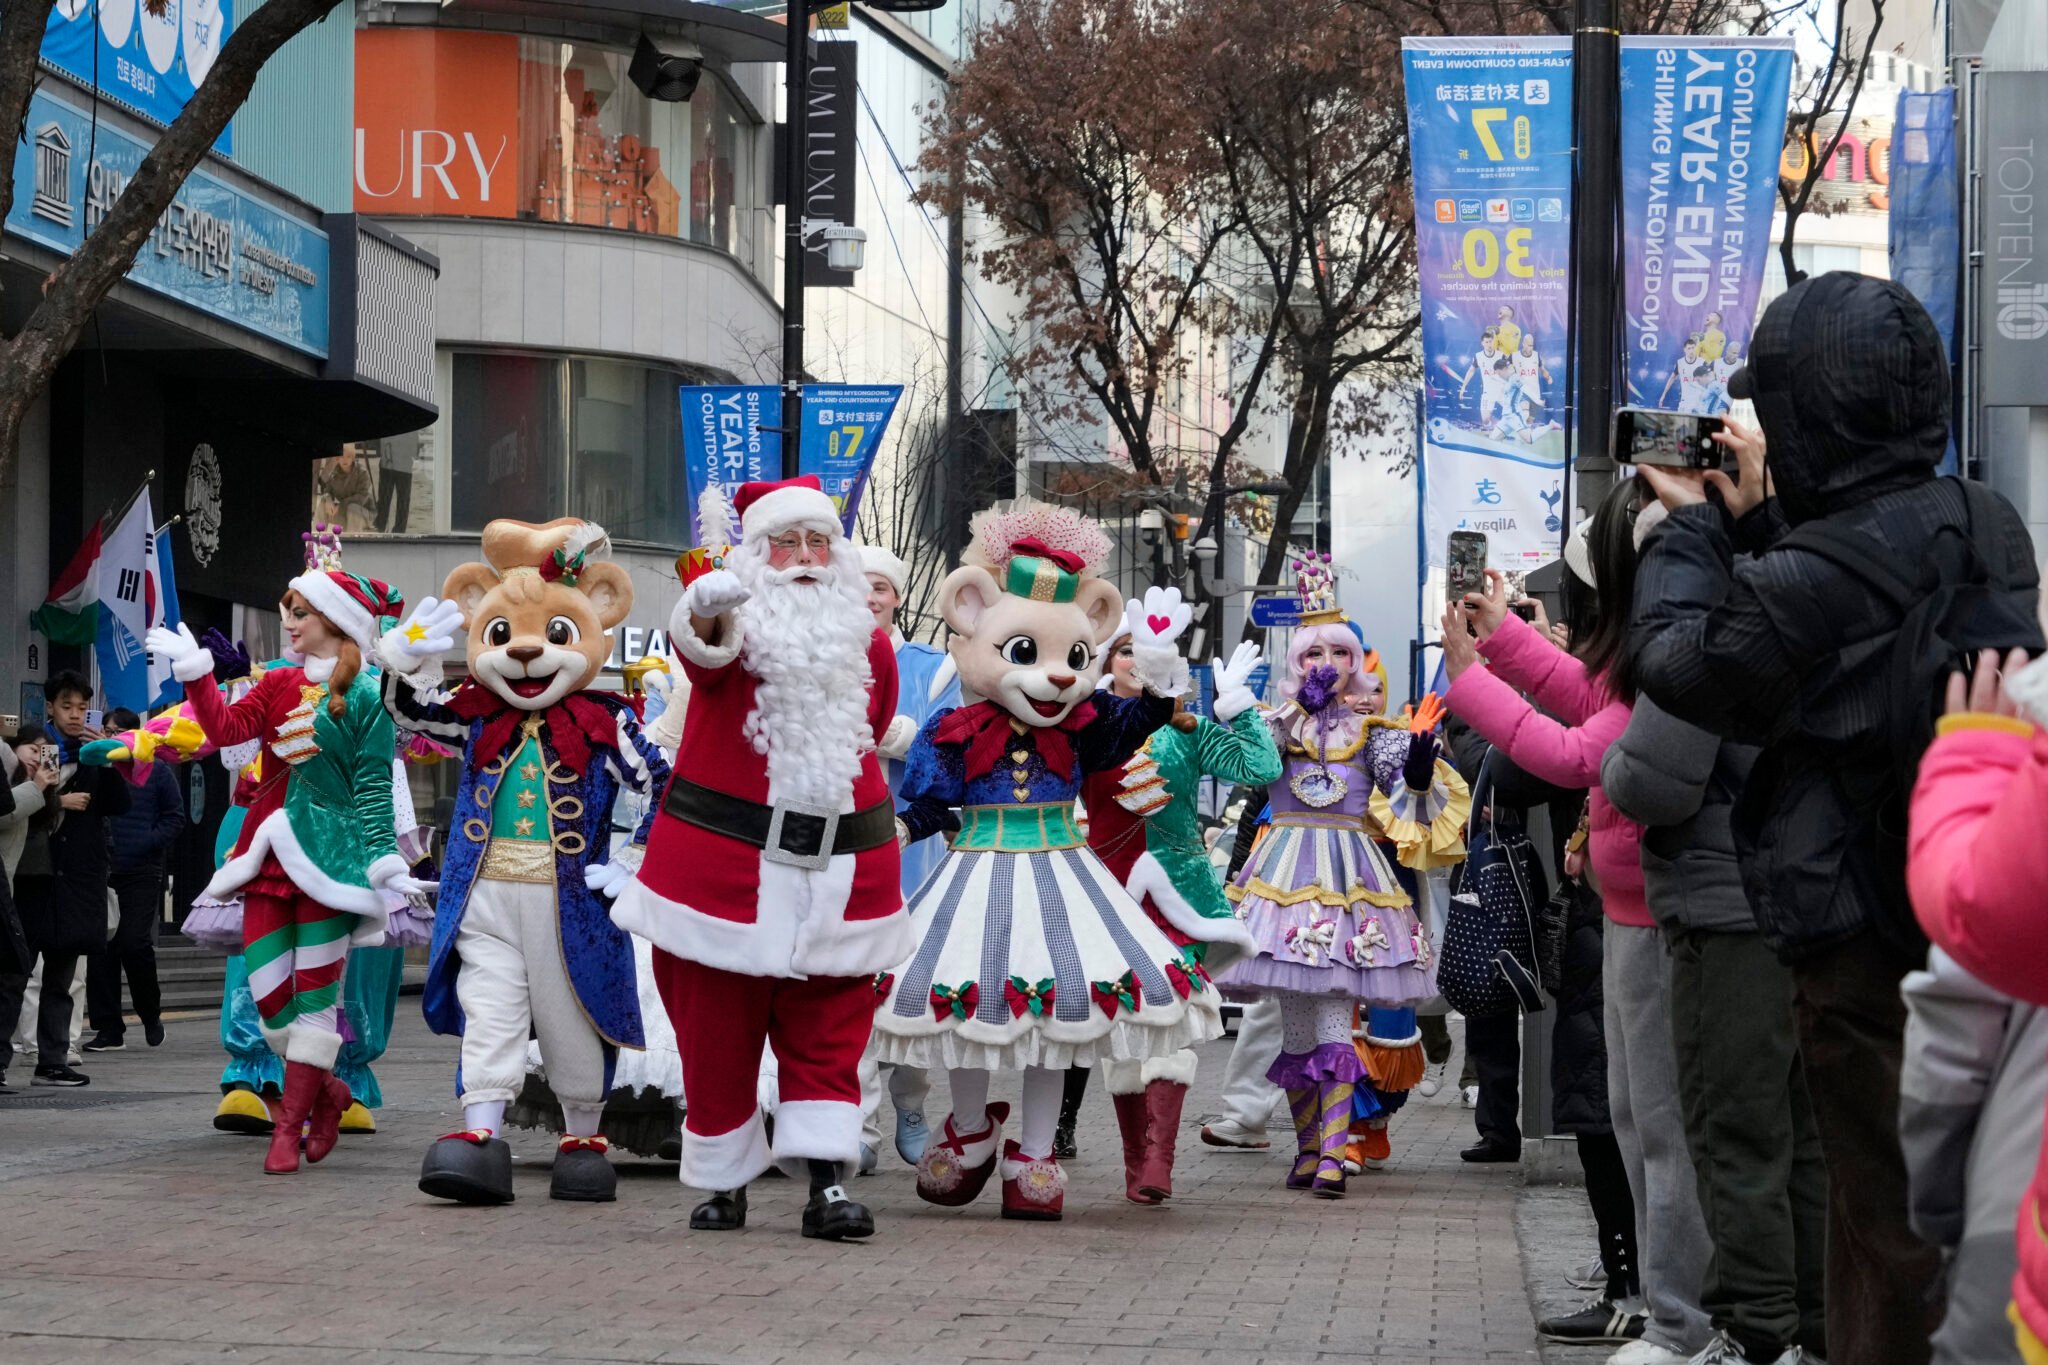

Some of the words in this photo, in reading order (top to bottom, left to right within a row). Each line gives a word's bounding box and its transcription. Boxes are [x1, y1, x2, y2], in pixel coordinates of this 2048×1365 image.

[809, 66, 836, 117] UM
[807, 132, 836, 258] LUXUY
[843, 425, 865, 457] 7
